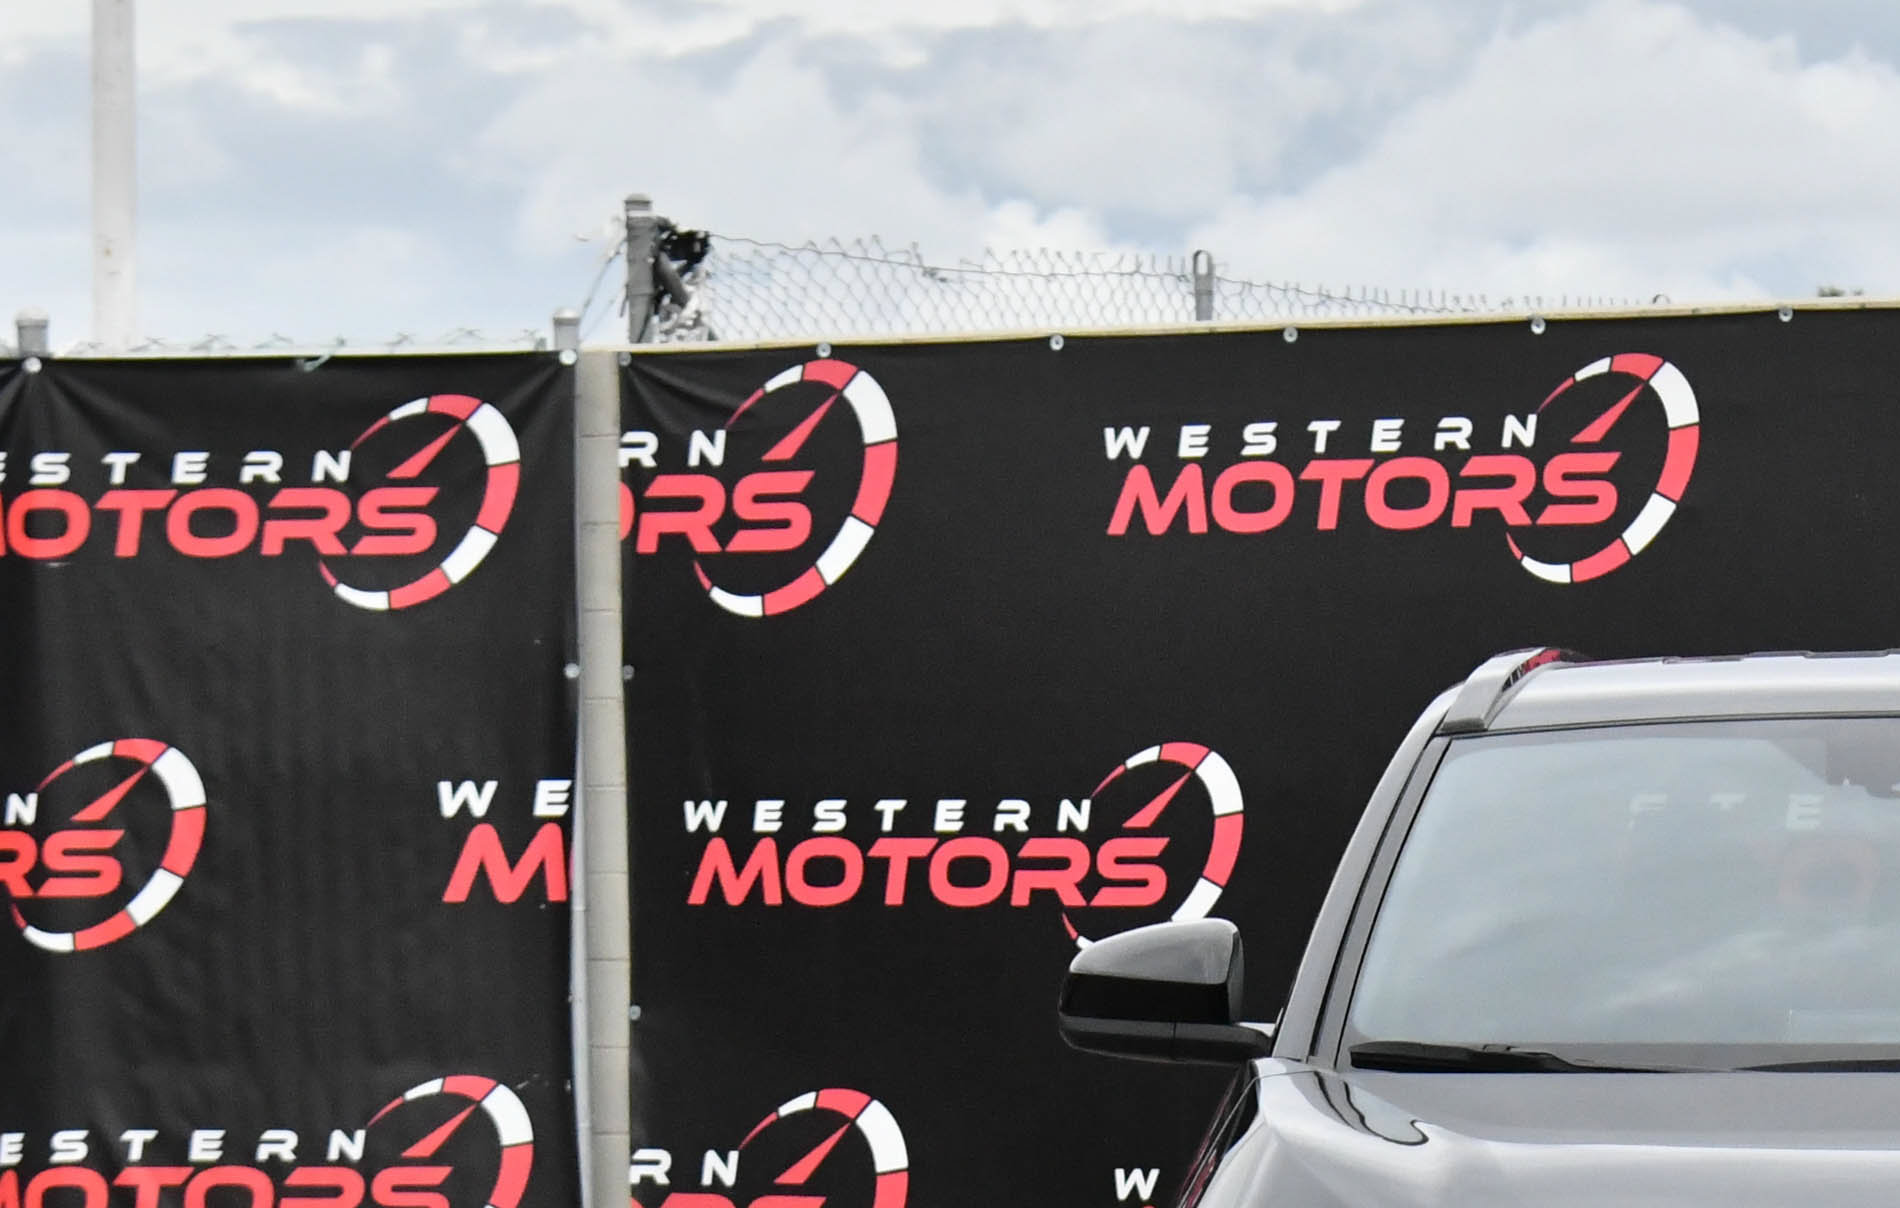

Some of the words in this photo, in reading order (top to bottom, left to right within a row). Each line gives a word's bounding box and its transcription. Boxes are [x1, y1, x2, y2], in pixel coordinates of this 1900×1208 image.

[0, 450, 352, 485] STERN
[1104, 414, 1538, 460] WESTERN
[0, 487, 440, 560] OTORS
[619, 471, 816, 555] RS
[1107, 452, 1622, 537] MOTORS
[684, 799, 1092, 833] WESTERN
[688, 836, 1170, 908] MOTORS
